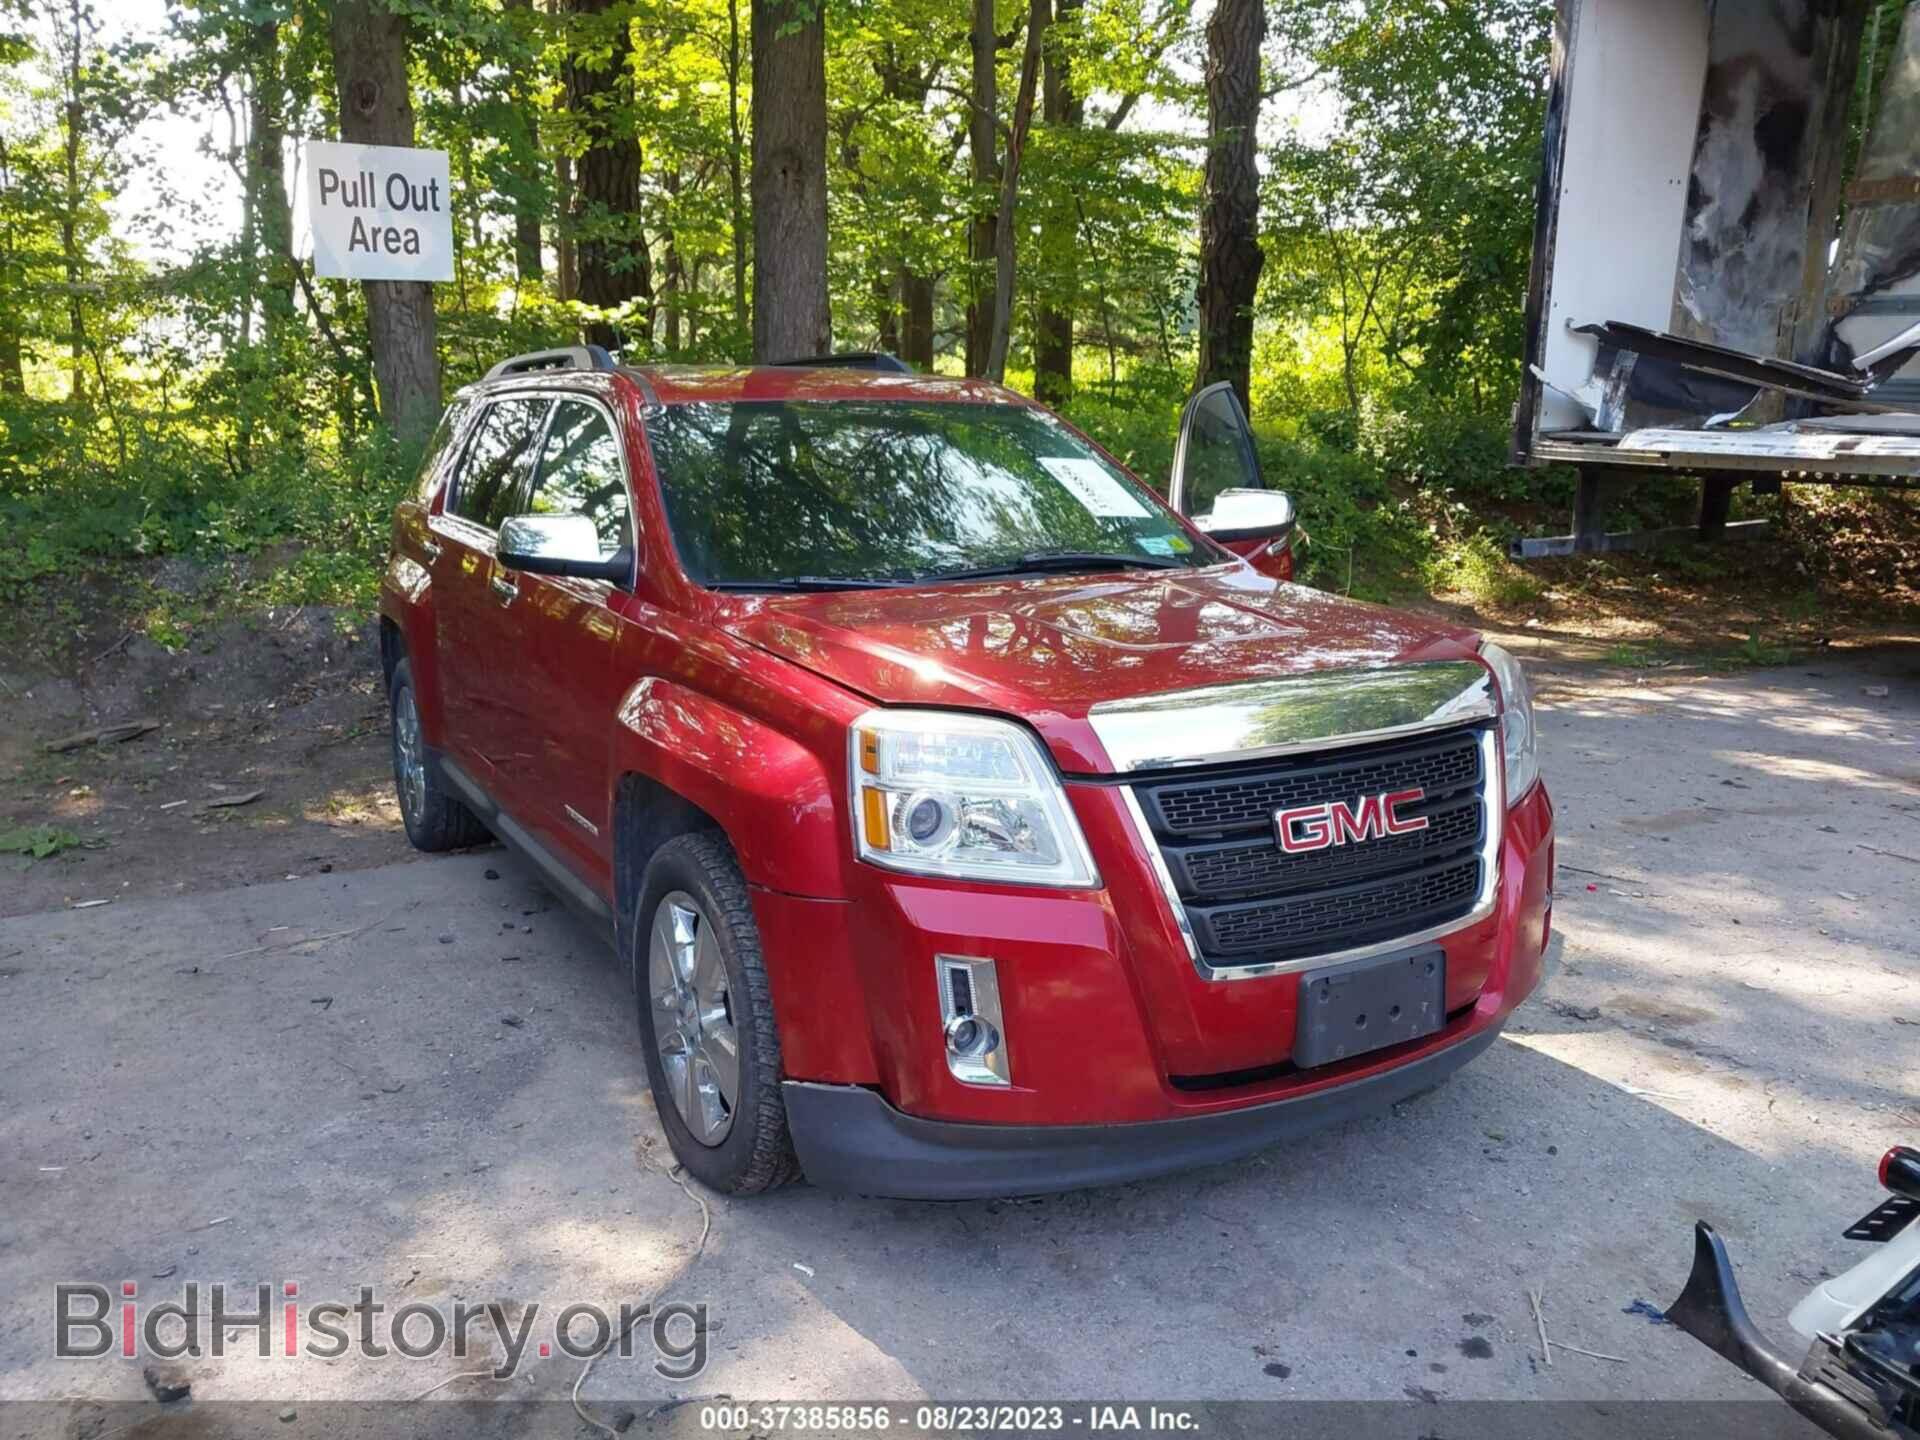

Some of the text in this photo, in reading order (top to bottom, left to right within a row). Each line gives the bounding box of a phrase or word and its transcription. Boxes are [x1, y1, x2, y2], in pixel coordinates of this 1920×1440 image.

[319, 168, 440, 211] Pull Out
[349, 216, 420, 255] Area
[1275, 788, 1429, 853] GMC
